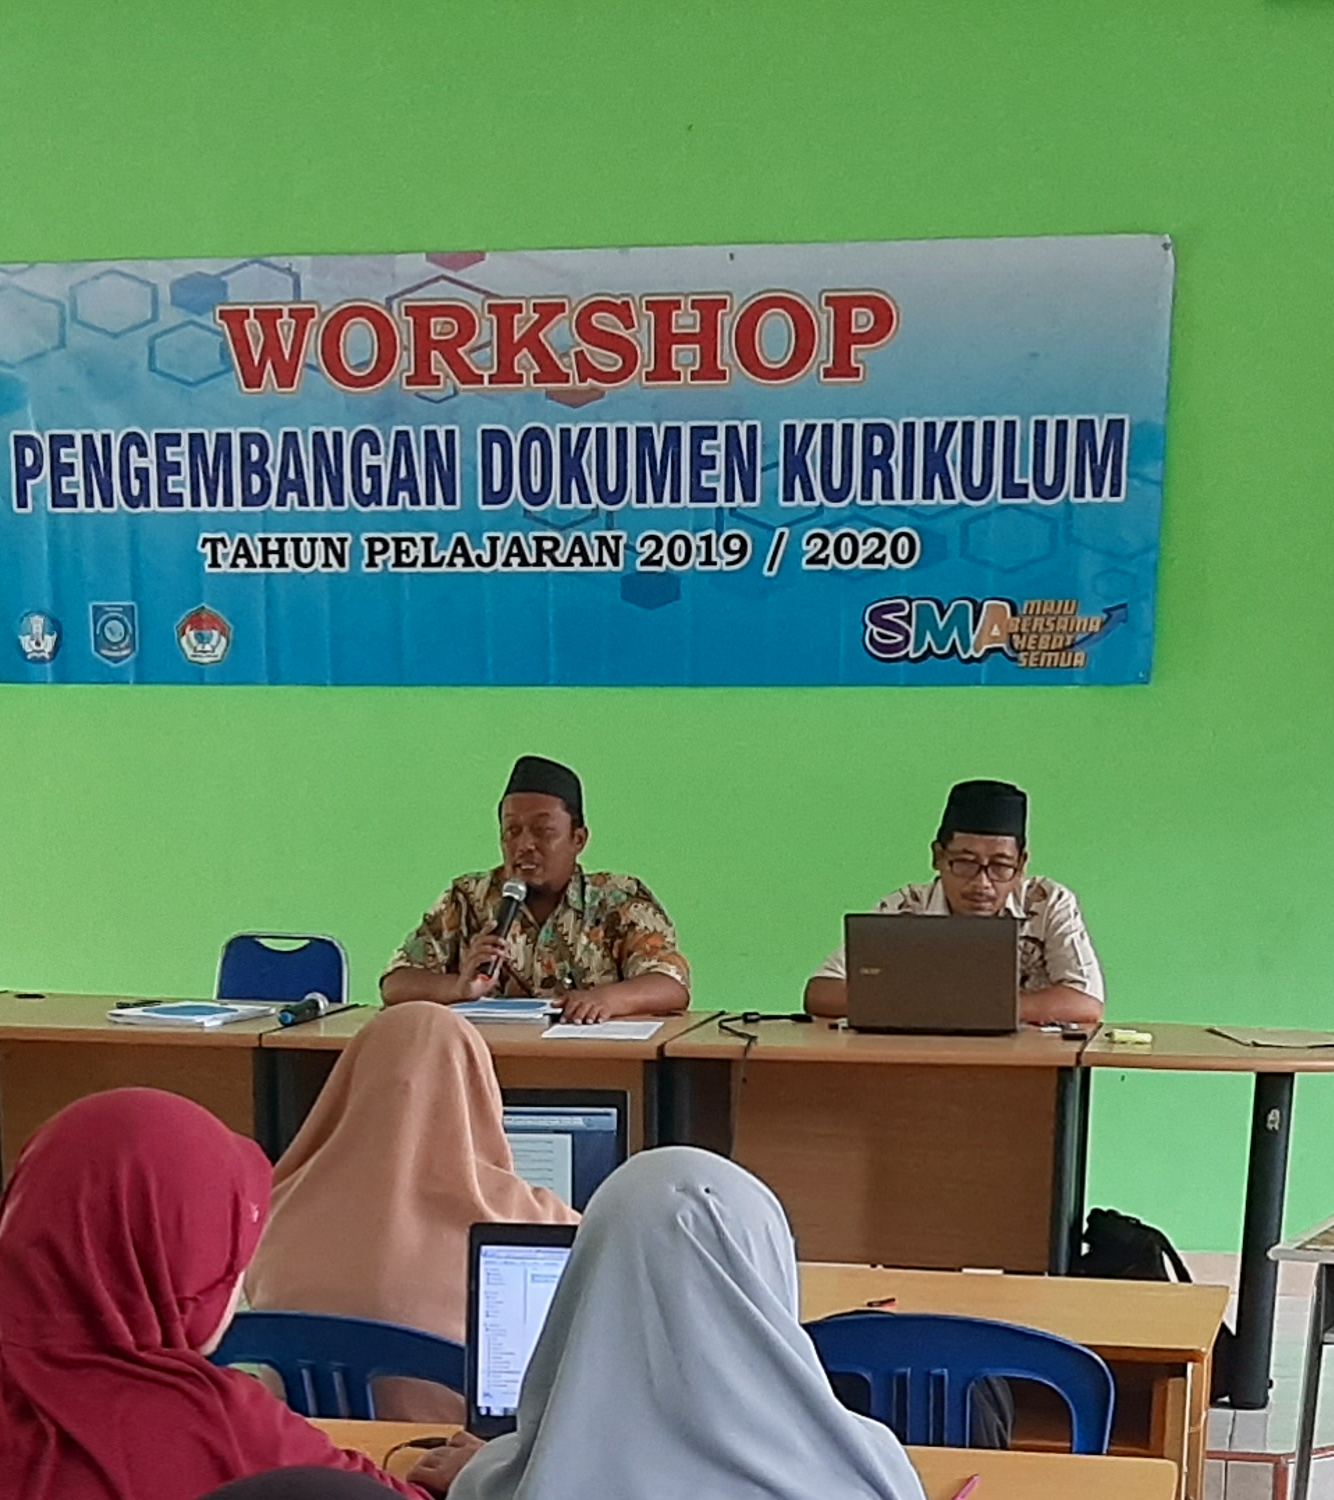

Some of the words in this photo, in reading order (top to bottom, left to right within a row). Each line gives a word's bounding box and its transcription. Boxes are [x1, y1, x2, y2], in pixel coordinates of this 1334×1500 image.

[215, 291, 898, 392] WORKSHOP
[11, 427, 458, 510] PENGEMBANGAN
[478, 422, 760, 506] DOKUMEN
[780, 416, 1128, 503] KURIKULUM
[201, 536, 349, 569] TAHUN
[364, 534, 624, 568] PELAJARAN
[638, 531, 749, 568] 2019
[766, 530, 786, 572] /
[804, 530, 918, 567] 2020
[1022, 600, 1077, 615] MAJU
[865, 599, 1014, 659] SMA
[1008, 616, 1102, 633] BERSAMA
[1013, 634, 1072, 650] HEBAT
[1018, 651, 1086, 668] SEMUA
